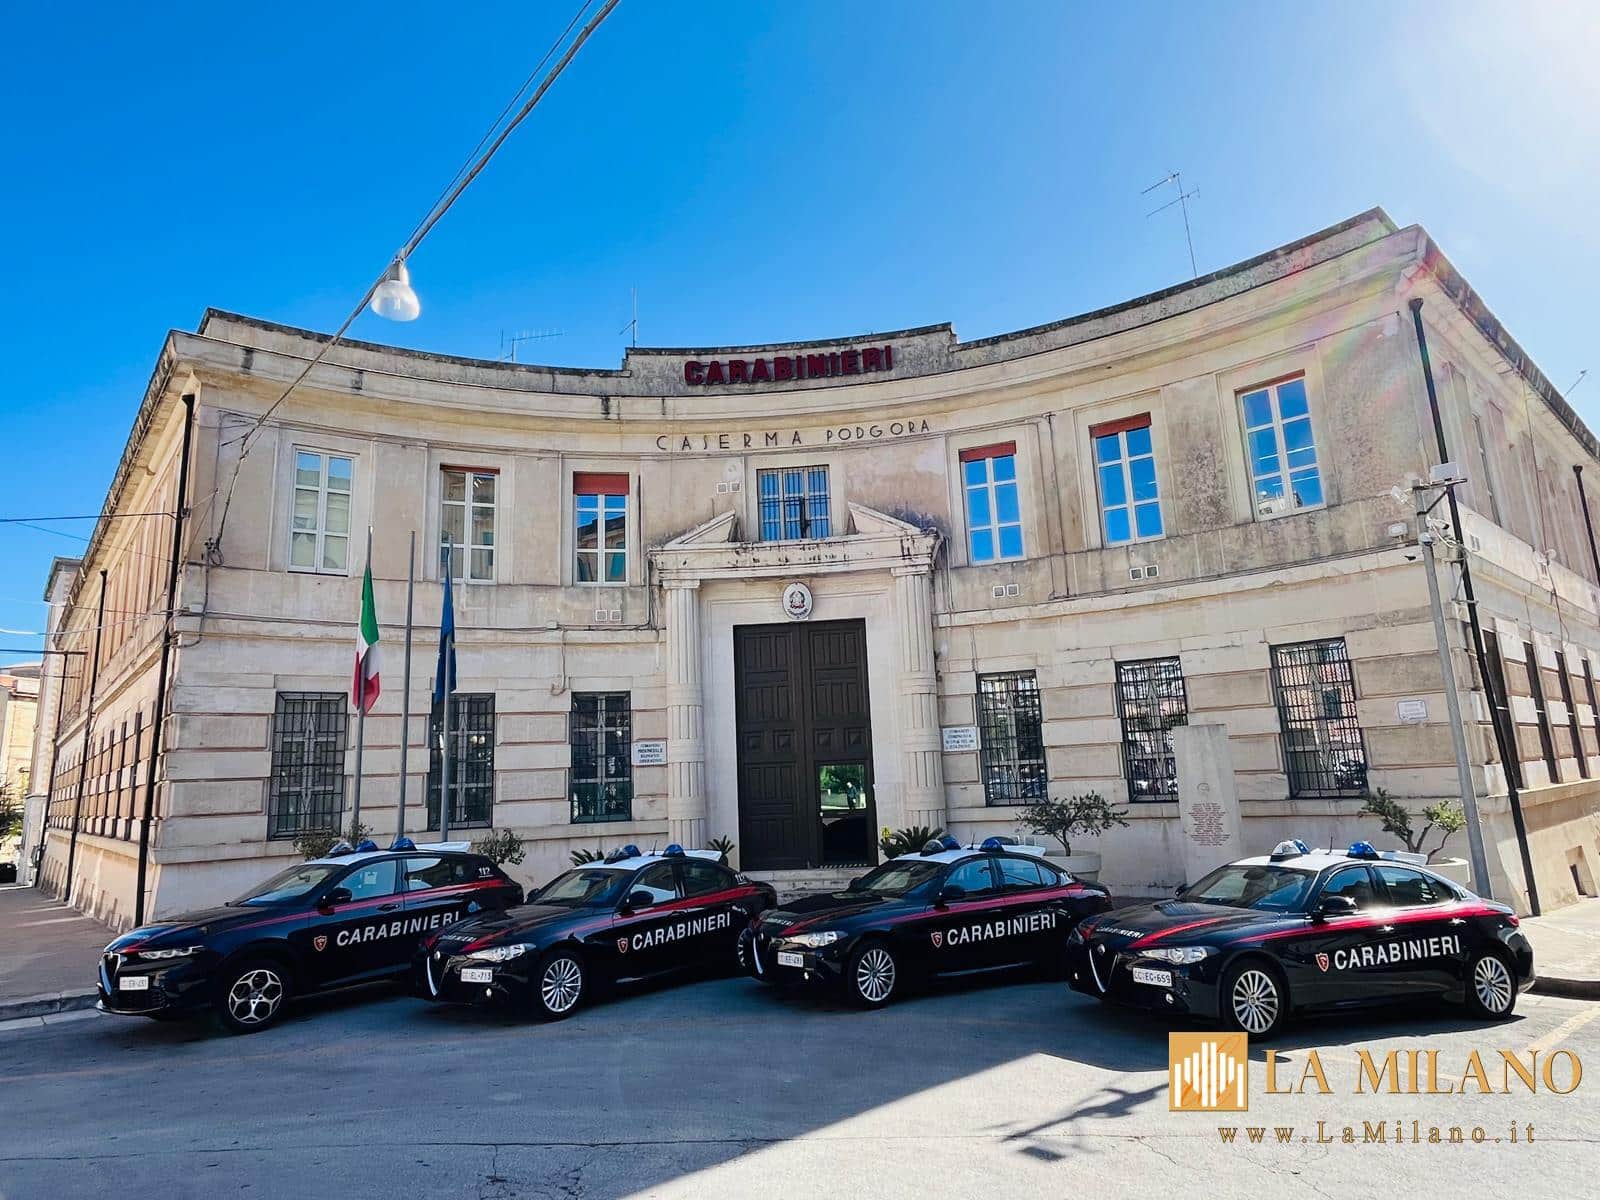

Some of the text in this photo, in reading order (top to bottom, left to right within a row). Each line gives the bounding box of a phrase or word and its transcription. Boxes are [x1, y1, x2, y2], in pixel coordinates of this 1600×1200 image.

[684, 345, 893, 385] CARABINIERI
[656, 419, 930, 451] CASERMA PODGORA
[336, 911, 460, 947] CARABINIERI
[632, 911, 731, 951] CARABINIERI
[947, 913, 1057, 946] CARABINIERI
[1334, 935, 1461, 971] CARABINIERI
